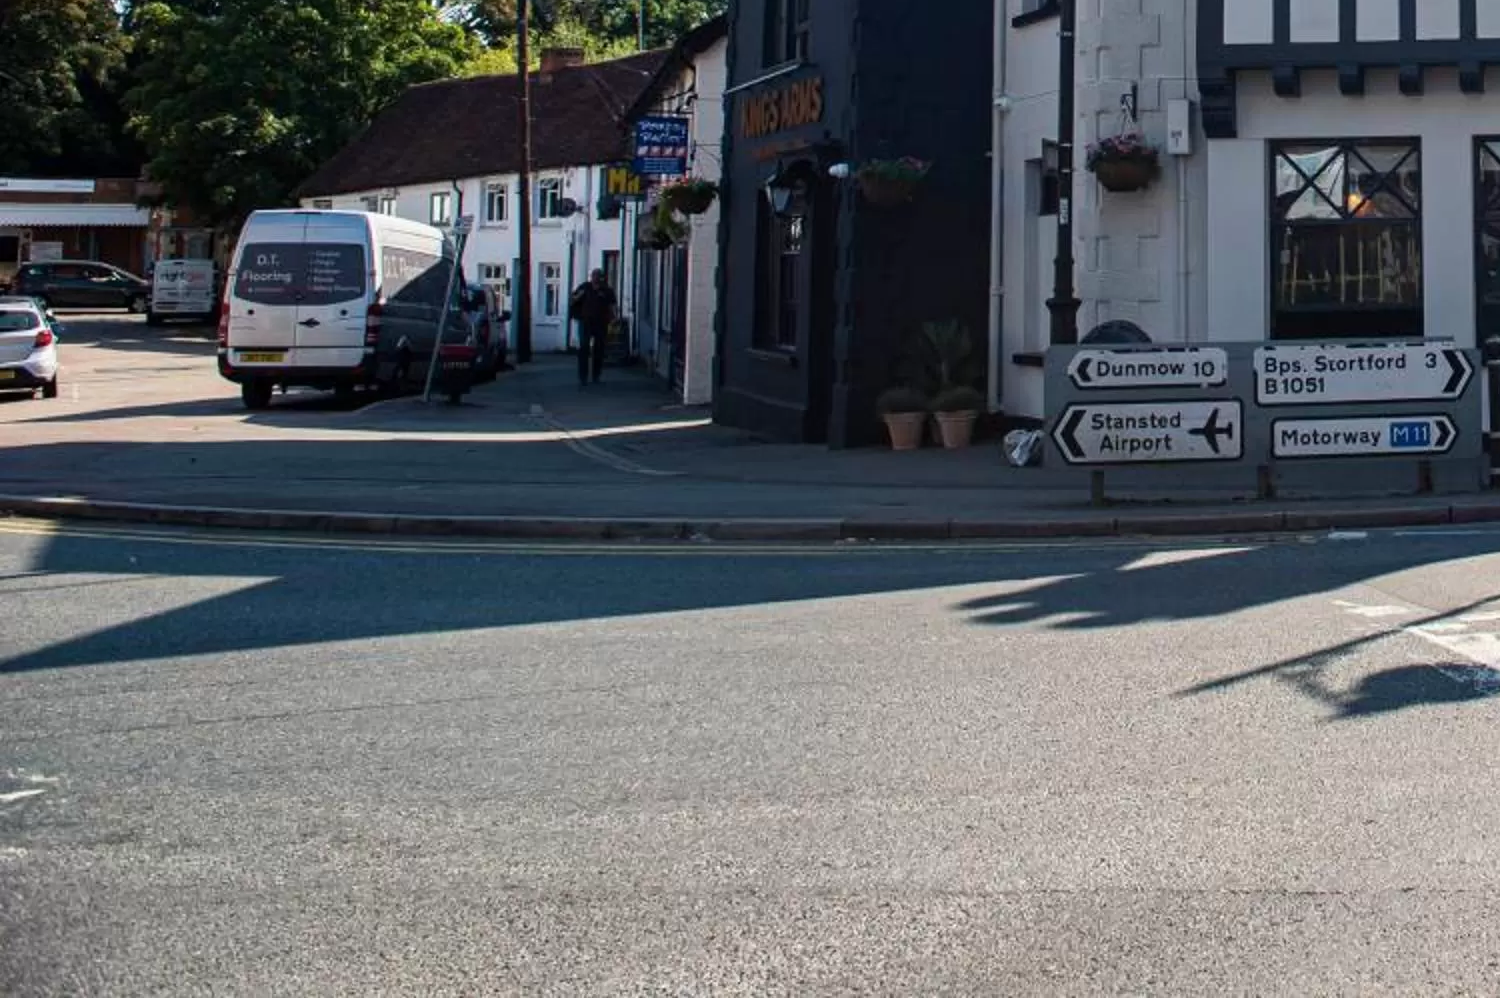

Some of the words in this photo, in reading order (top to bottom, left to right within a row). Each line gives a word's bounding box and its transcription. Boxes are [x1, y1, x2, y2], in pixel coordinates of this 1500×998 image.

[780, 77, 823, 129] ARMS
[241, 269, 292, 283] Flooring
[1097, 360, 1184, 377] Dunmow
[1192, 361, 1215, 377] 10
[1264, 356, 1307, 376] Bps.
[1314, 353, 1407, 372] Stortford
[1425, 352, 1437, 369] 3
[1091, 411, 1181, 430] Stansted
[1100, 433, 1172, 453] Airport
[1281, 429, 1381, 447] Motorway
